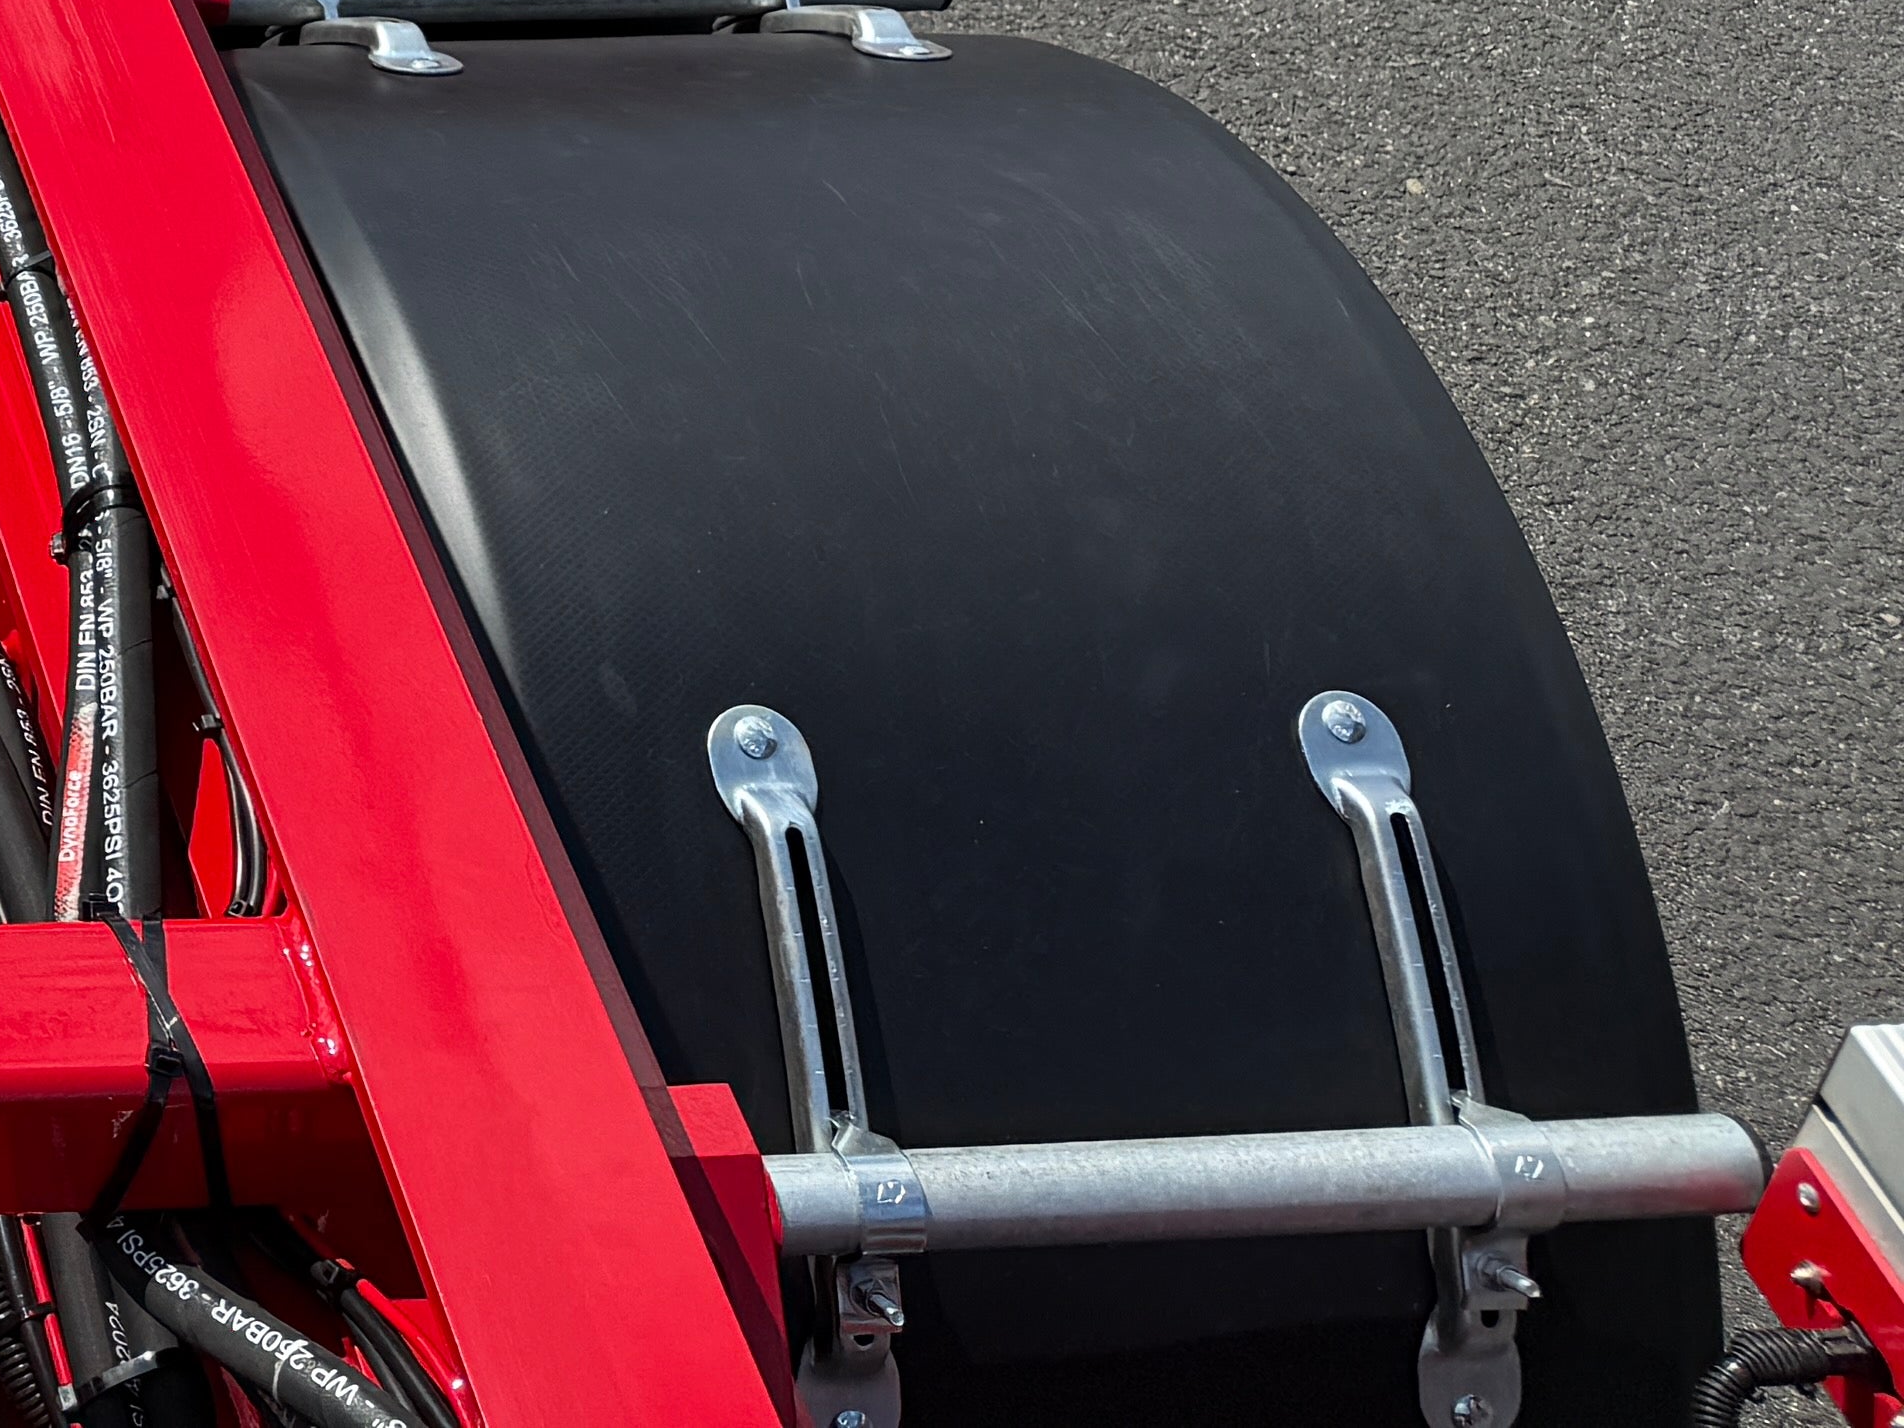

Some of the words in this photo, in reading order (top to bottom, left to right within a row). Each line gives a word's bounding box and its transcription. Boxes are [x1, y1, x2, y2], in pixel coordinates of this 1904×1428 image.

[34, 330, 60, 365] WP
[48, 380, 74, 418] 5/8"
[61, 432, 90, 489] DN16
[97, 597, 114, 638] WP
[75, 651, 97, 691] DIN
[99, 645, 119, 740] 250BAR
[57, 770, 83, 863] DynaForce
[101, 759, 123, 861] 3625PSI
[116, 1230, 199, 1300] 3625PSI
[210, 1297, 309, 1371] 250BAR
[311, 1366, 360, 1406] WP
